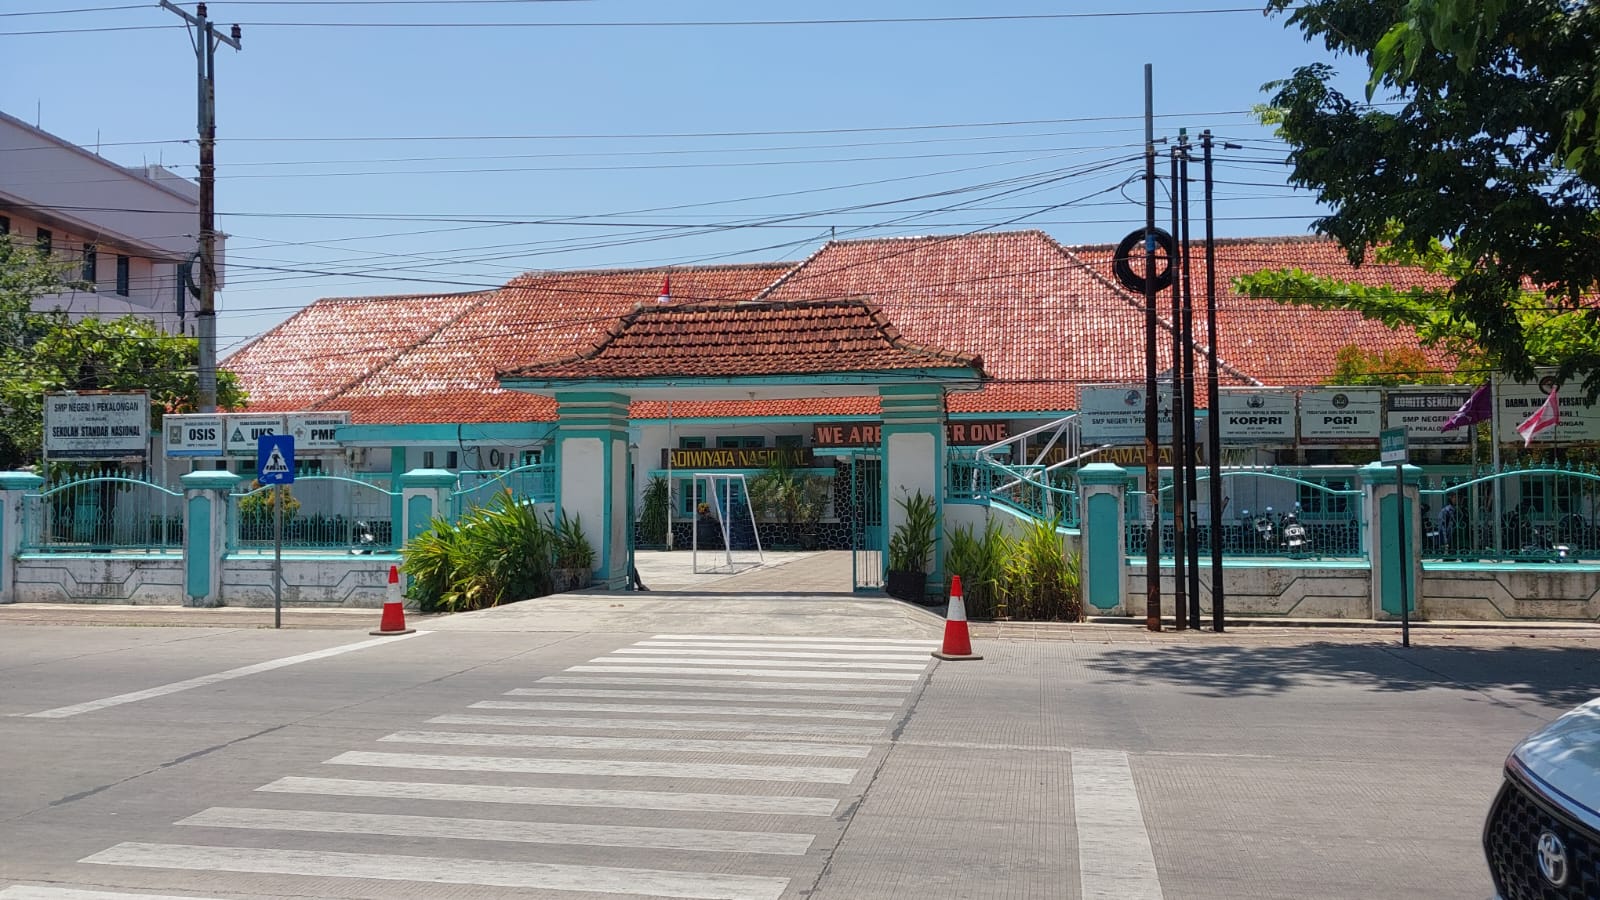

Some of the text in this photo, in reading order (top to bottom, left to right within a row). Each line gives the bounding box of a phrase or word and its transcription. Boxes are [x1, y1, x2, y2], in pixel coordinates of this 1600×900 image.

[54, 402, 68, 412] SMP
[68, 402, 91, 412] NEGERI
[96, 402, 139, 412] PEKALONGAN
[1394, 396, 1464, 408] KOMITE SEKOLAH
[1229, 416, 1282, 425] KORPRI
[1323, 416, 1358, 425] PGRI
[52, 425, 141, 437] SEKOLAH STANDAR NASIONAL
[188, 428, 216, 441] OSIS
[250, 427, 275, 440] UKS
[817, 426, 844, 444] WE
[848, 425, 881, 443] ARE
[970, 423, 1007, 441] ONE
[670, 450, 736, 467] ADIWIYATA
